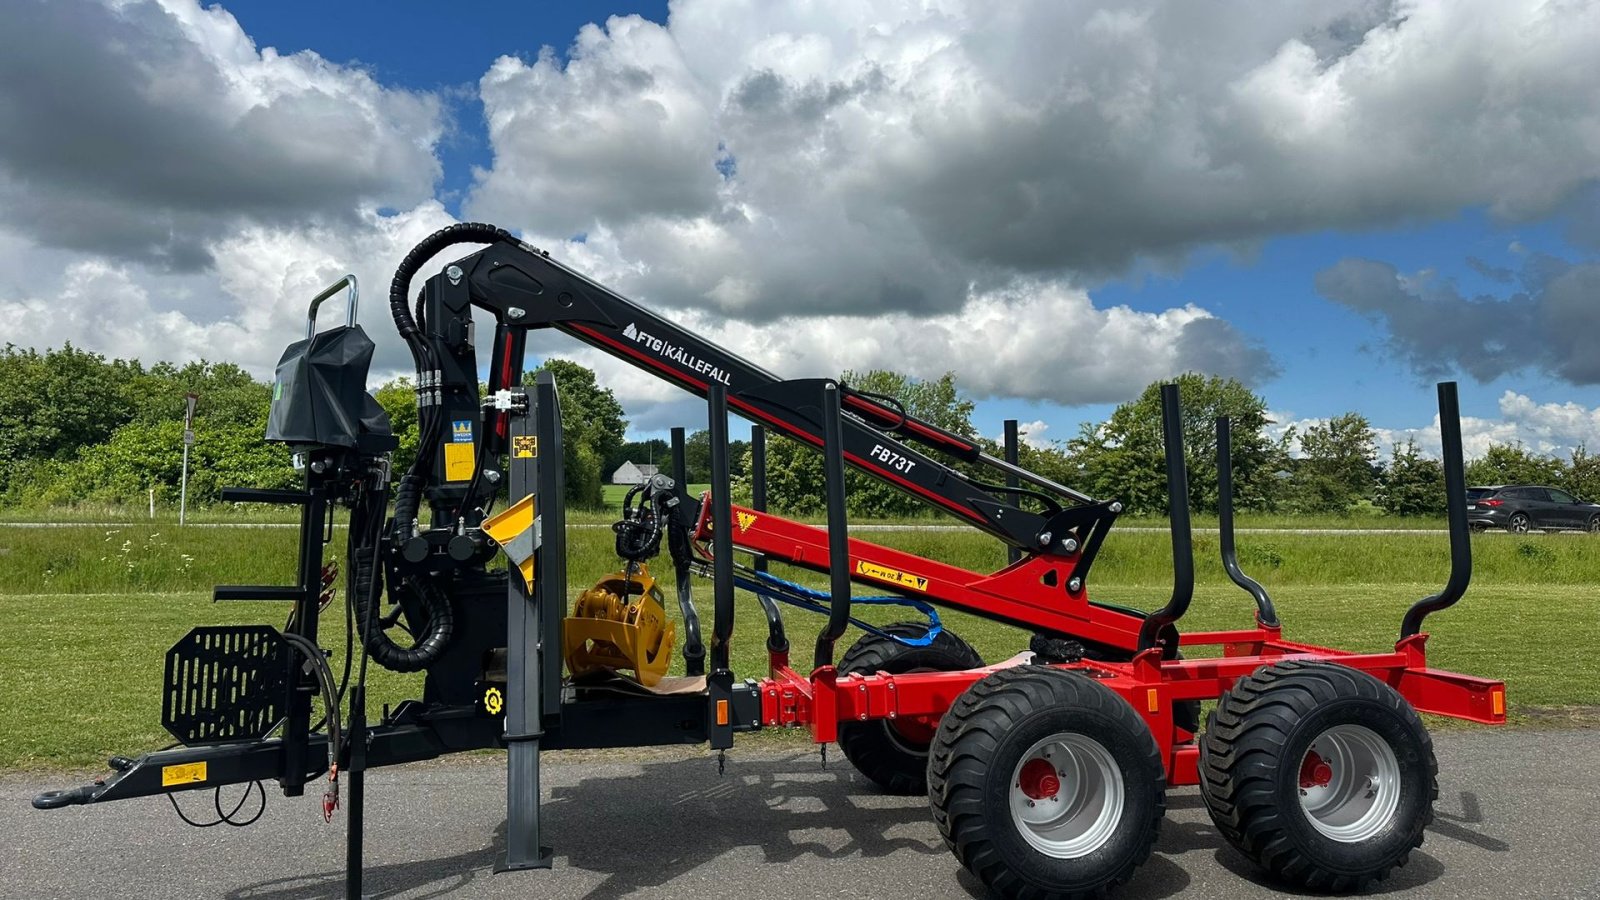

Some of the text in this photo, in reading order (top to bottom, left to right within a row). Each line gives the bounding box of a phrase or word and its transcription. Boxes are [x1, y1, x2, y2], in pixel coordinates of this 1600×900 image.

[636, 331, 731, 386] FTG KÄLLEFALL
[870, 444, 916, 474] FB73T
